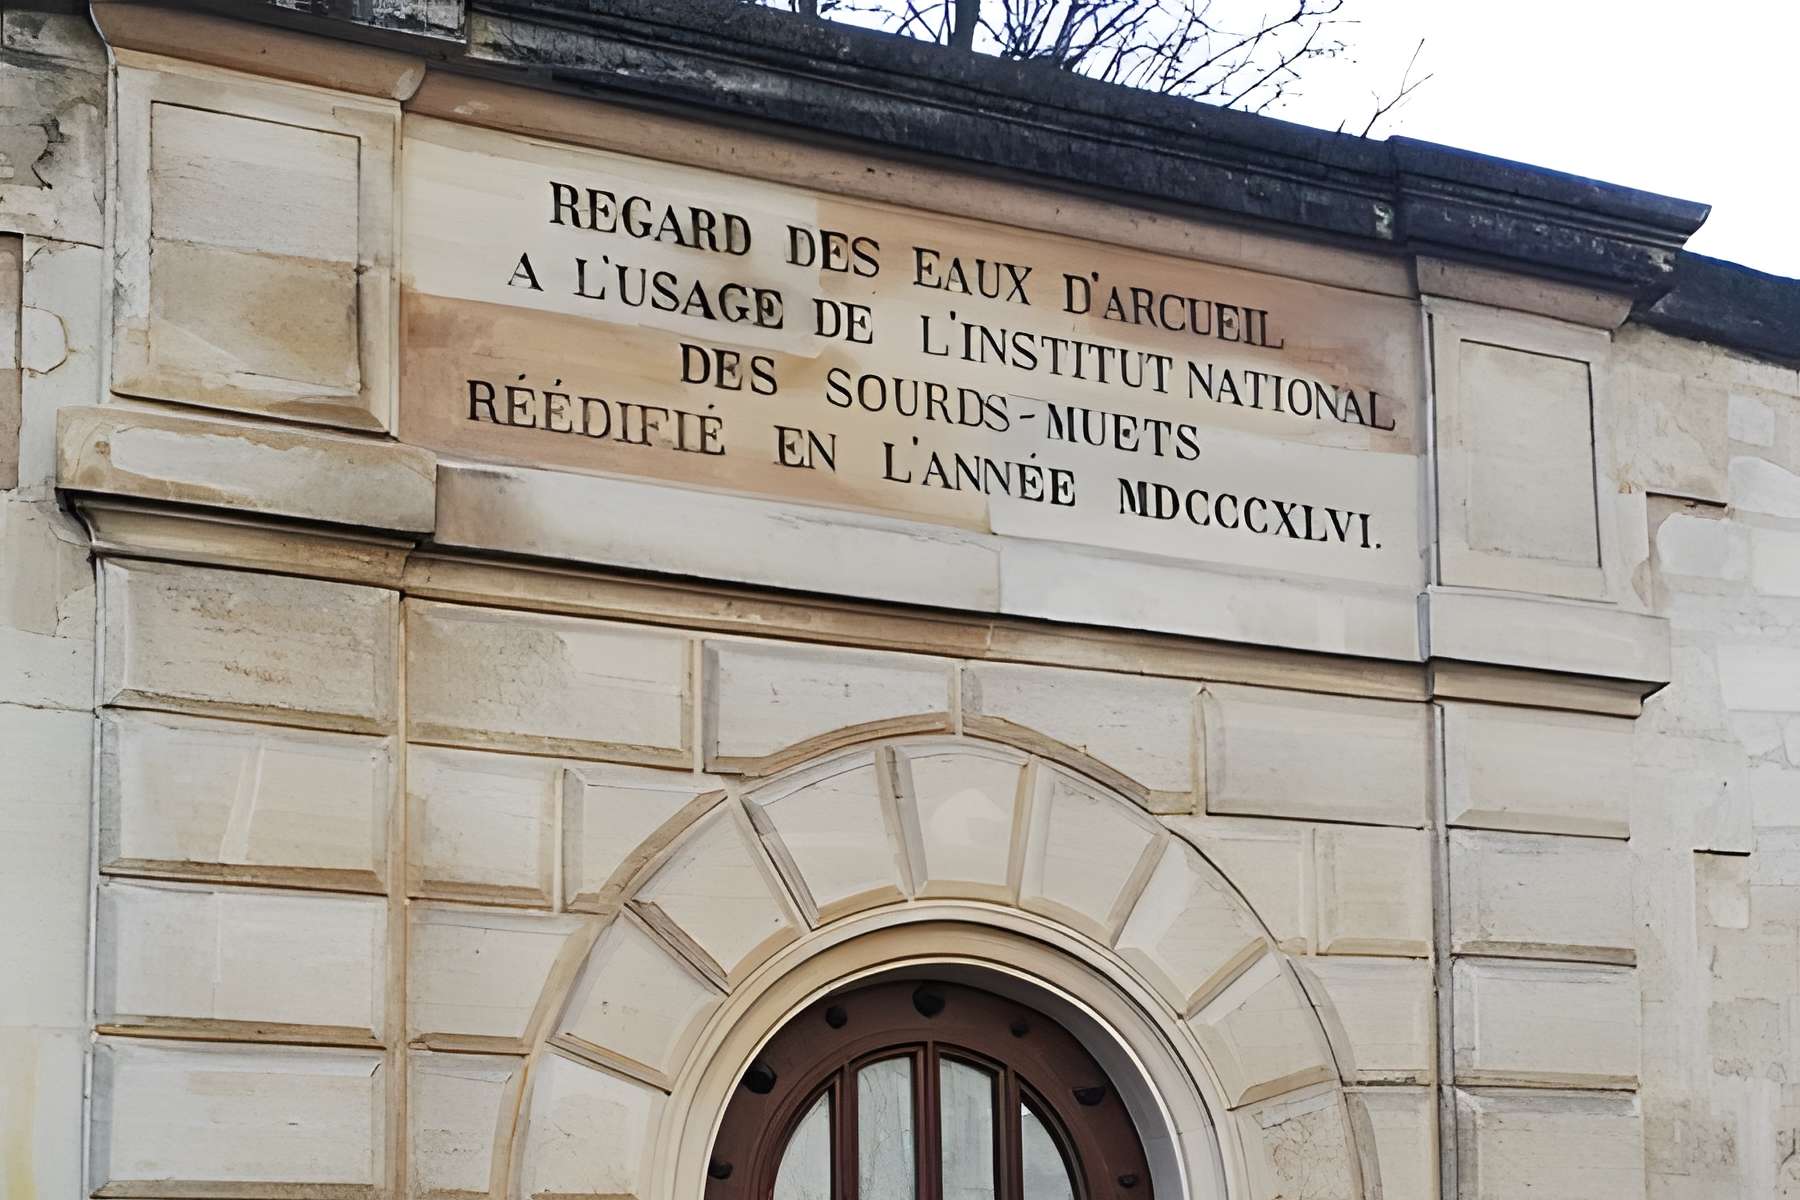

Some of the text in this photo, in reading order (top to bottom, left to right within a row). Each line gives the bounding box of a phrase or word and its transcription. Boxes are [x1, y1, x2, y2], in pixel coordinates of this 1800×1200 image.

[507, 252, 1396, 432] A L'USAGE DE L'INSTITUT NATIONAL
[550, 181, 1284, 350] REGARD DES EAUX D'ARCUEIL
[679, 342, 778, 396] DES
[466, 373, 1383, 550] RÉÉDIFIÉ EN L'ANNÉE MDCCCXLVI.
